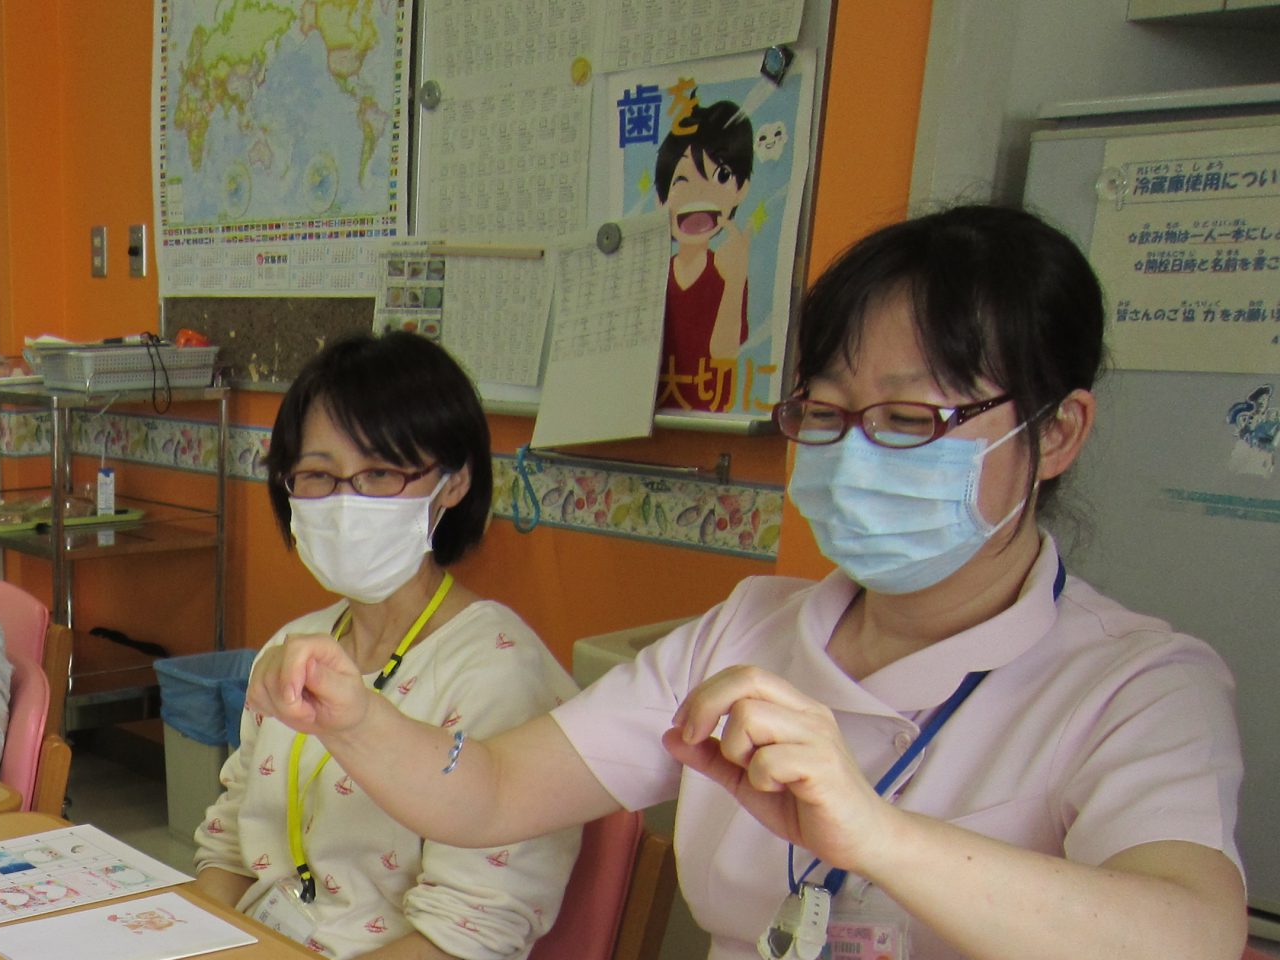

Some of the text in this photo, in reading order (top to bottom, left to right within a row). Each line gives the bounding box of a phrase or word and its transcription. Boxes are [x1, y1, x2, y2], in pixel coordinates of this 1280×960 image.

[617, 76, 700, 149] 歯を
[659, 354, 778, 413] 大切に
